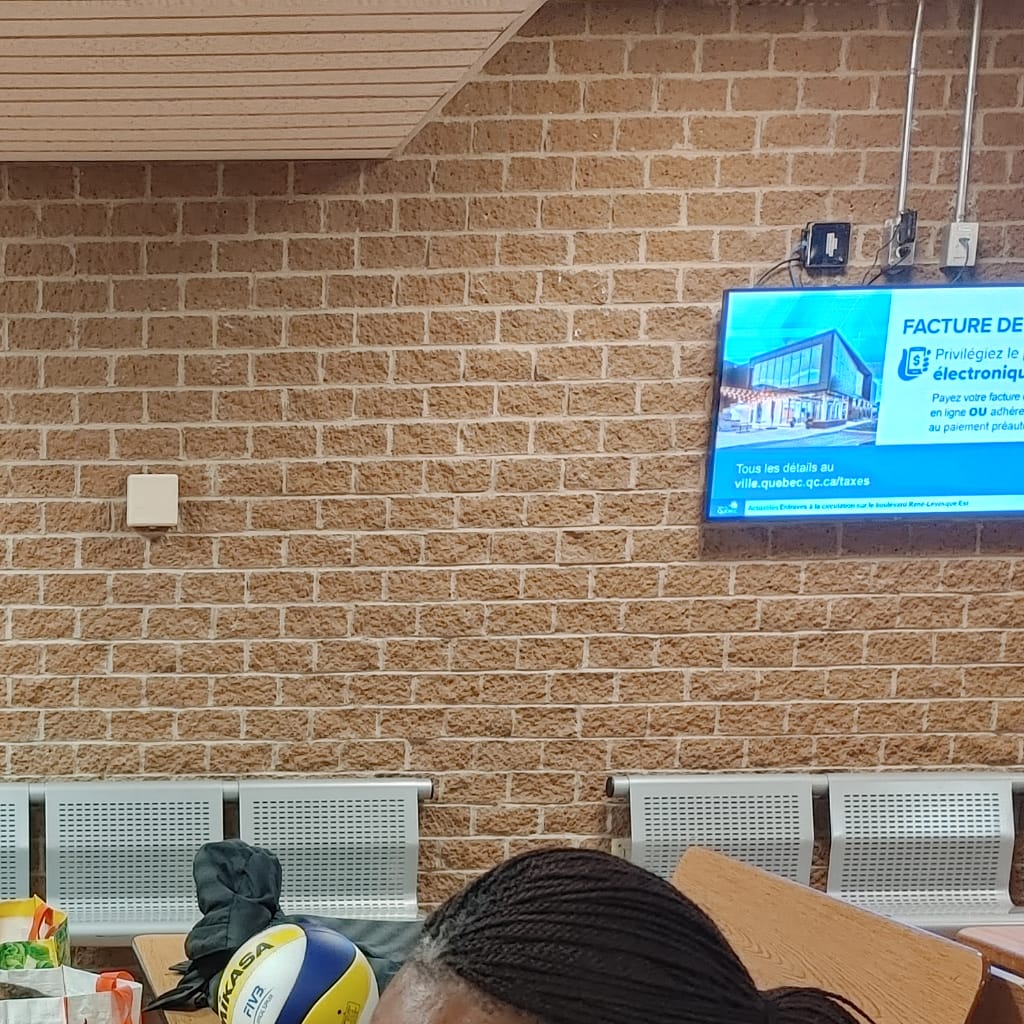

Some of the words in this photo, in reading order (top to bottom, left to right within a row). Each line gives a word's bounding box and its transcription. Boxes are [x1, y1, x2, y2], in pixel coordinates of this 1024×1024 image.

[903, 317, 993, 335] FACTURE
[997, 316, 1024, 333] DE
[935, 347, 1004, 363] Privilégiez
[1007, 346, 1020, 359] le
[932, 392, 962, 404] Payez
[963, 392, 987, 402] votre
[989, 391, 1021, 401] facture
[930, 409, 942, 418] en
[944, 407, 966, 419] ligne
[969, 407, 987, 417] OU
[928, 423, 941, 433] au
[943, 421, 990, 434] paiement
[736, 463, 762, 474] Tous
[764, 463, 780, 474] les
[782, 461, 818, 473] détails
[820, 462, 834, 473] au
[734, 475, 871, 491] ville.quebec.qc.ca/taxes
[243, 985, 265, 1019] FIVB
